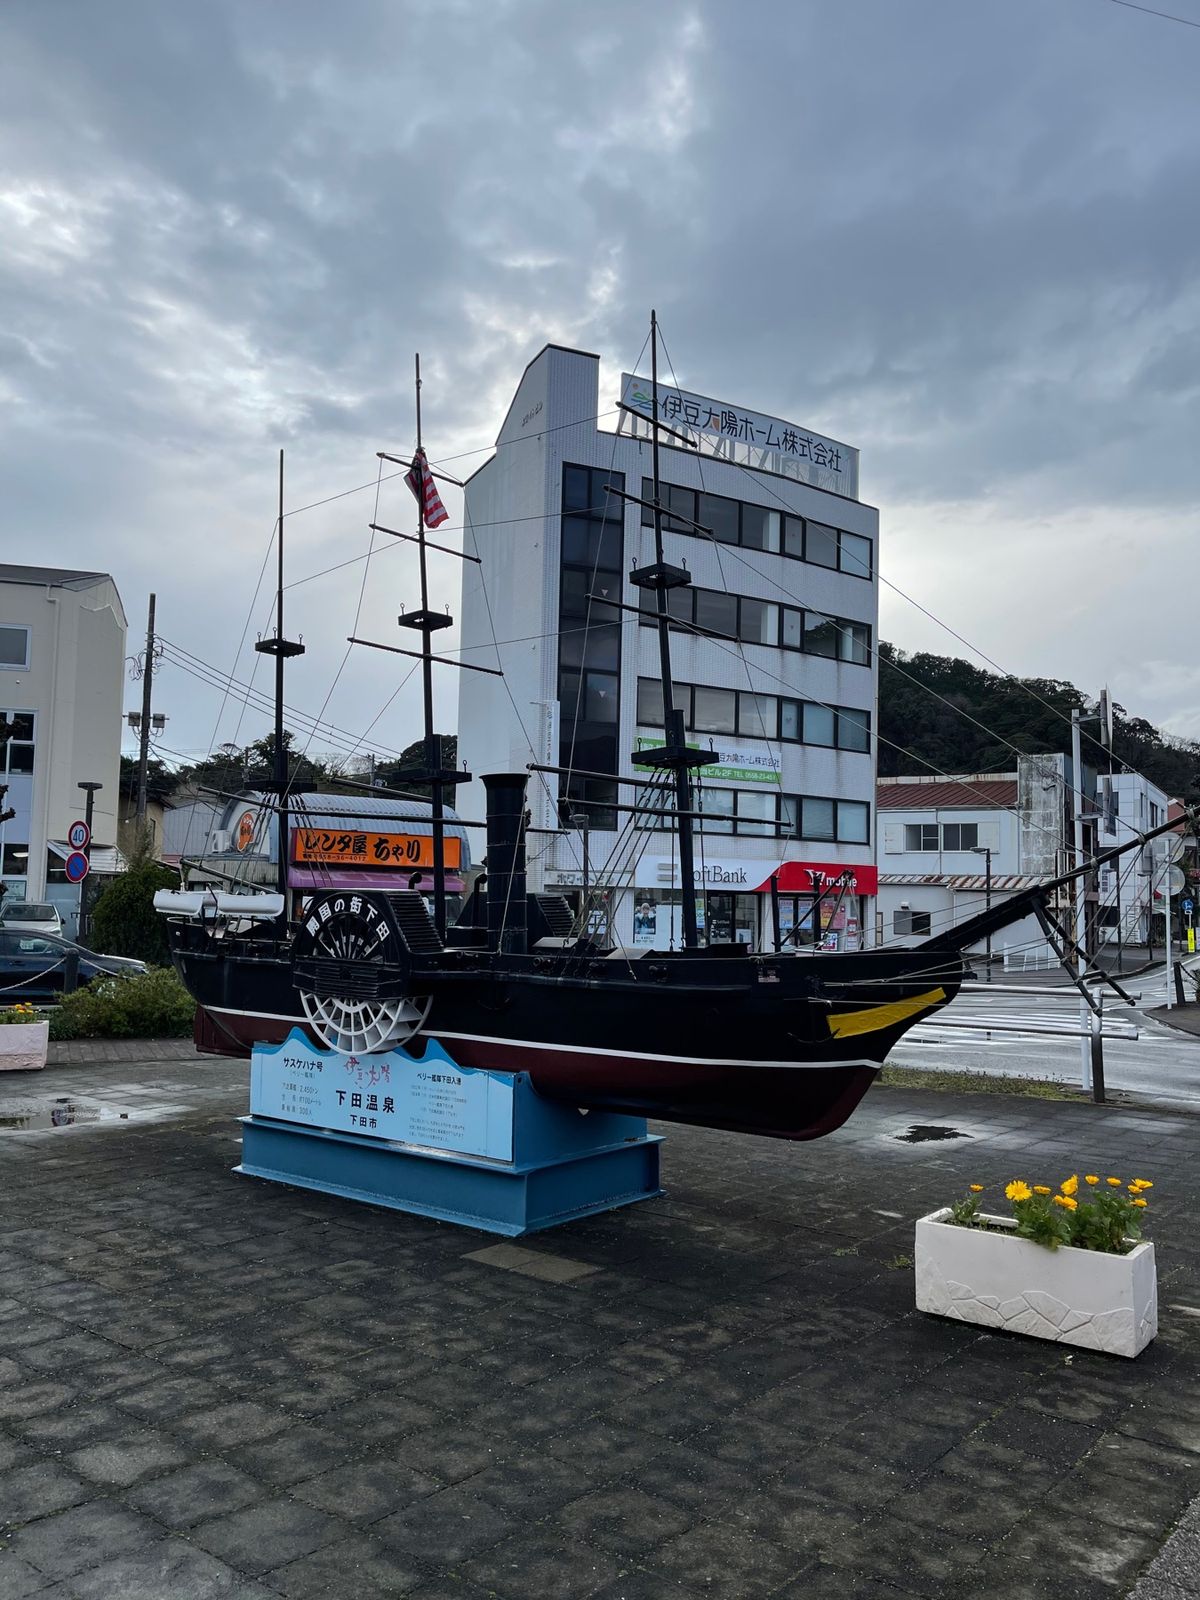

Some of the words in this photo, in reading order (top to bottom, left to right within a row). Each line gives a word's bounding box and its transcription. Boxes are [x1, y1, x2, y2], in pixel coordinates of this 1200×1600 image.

[719, 752, 780, 767] 豆太陽ホーム株式会社
[73, 829, 84, 842] 40
[305, 831, 367, 854] レンタ屋
[373, 836, 421, 863] ちゃり
[692, 865, 748, 884] oftBank
[283, 1057, 323, 1072] サスケハナ号
[336, 1090, 395, 1114] 下田温泉
[350, 1114, 377, 1129] 下田市
